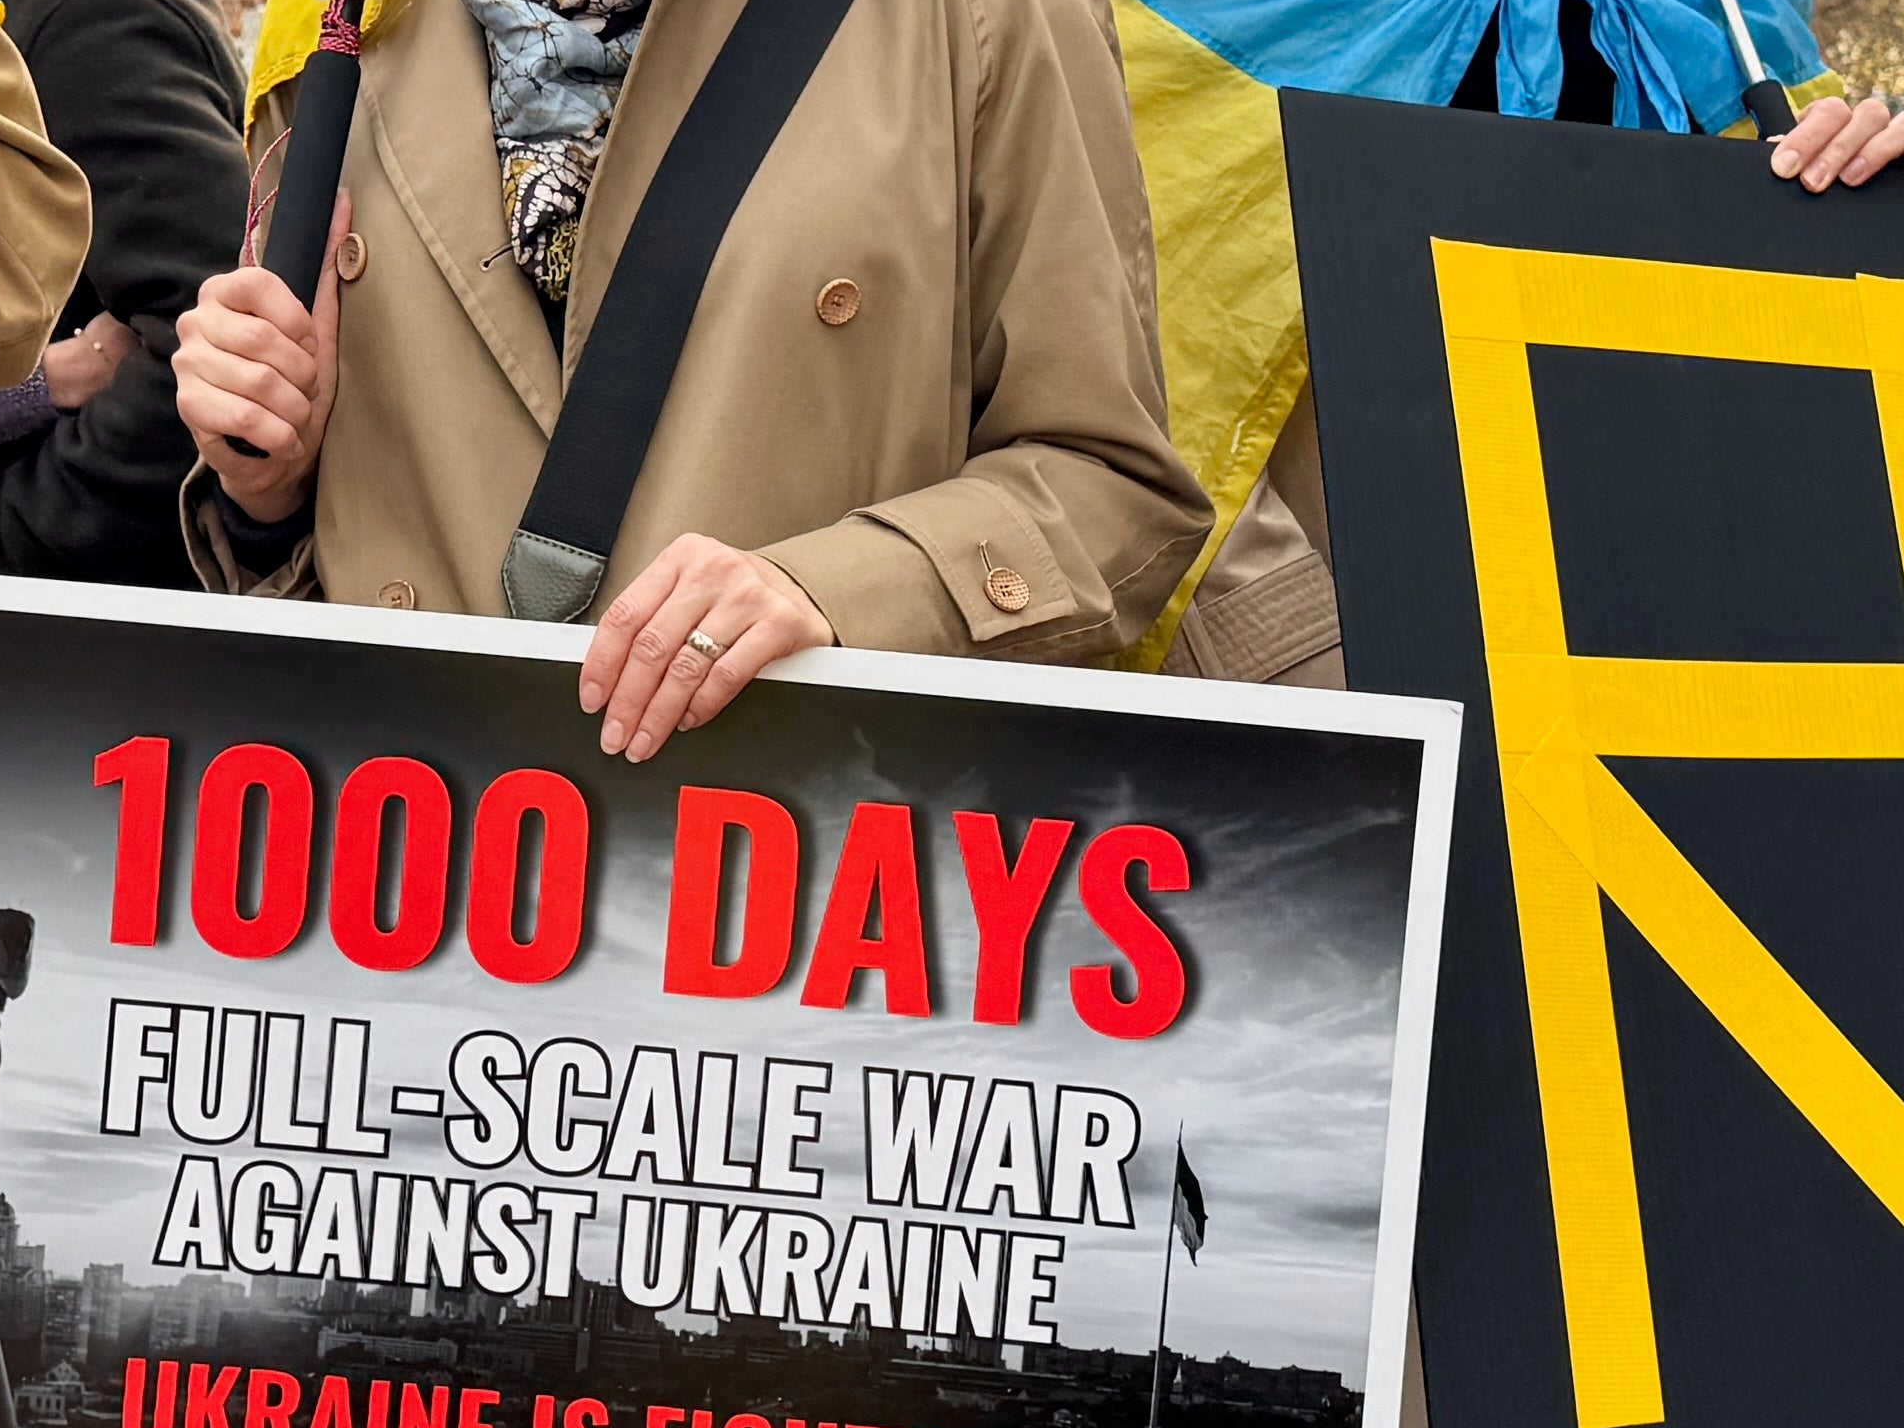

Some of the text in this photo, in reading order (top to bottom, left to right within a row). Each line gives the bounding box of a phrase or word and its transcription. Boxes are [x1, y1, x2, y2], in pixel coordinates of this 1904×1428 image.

[93, 735, 1191, 1040] 1000 DAYS
[100, 998, 1142, 1229] FULL-SCALE WAR
[152, 1154, 1065, 1346] AGAINST UKRAINE
